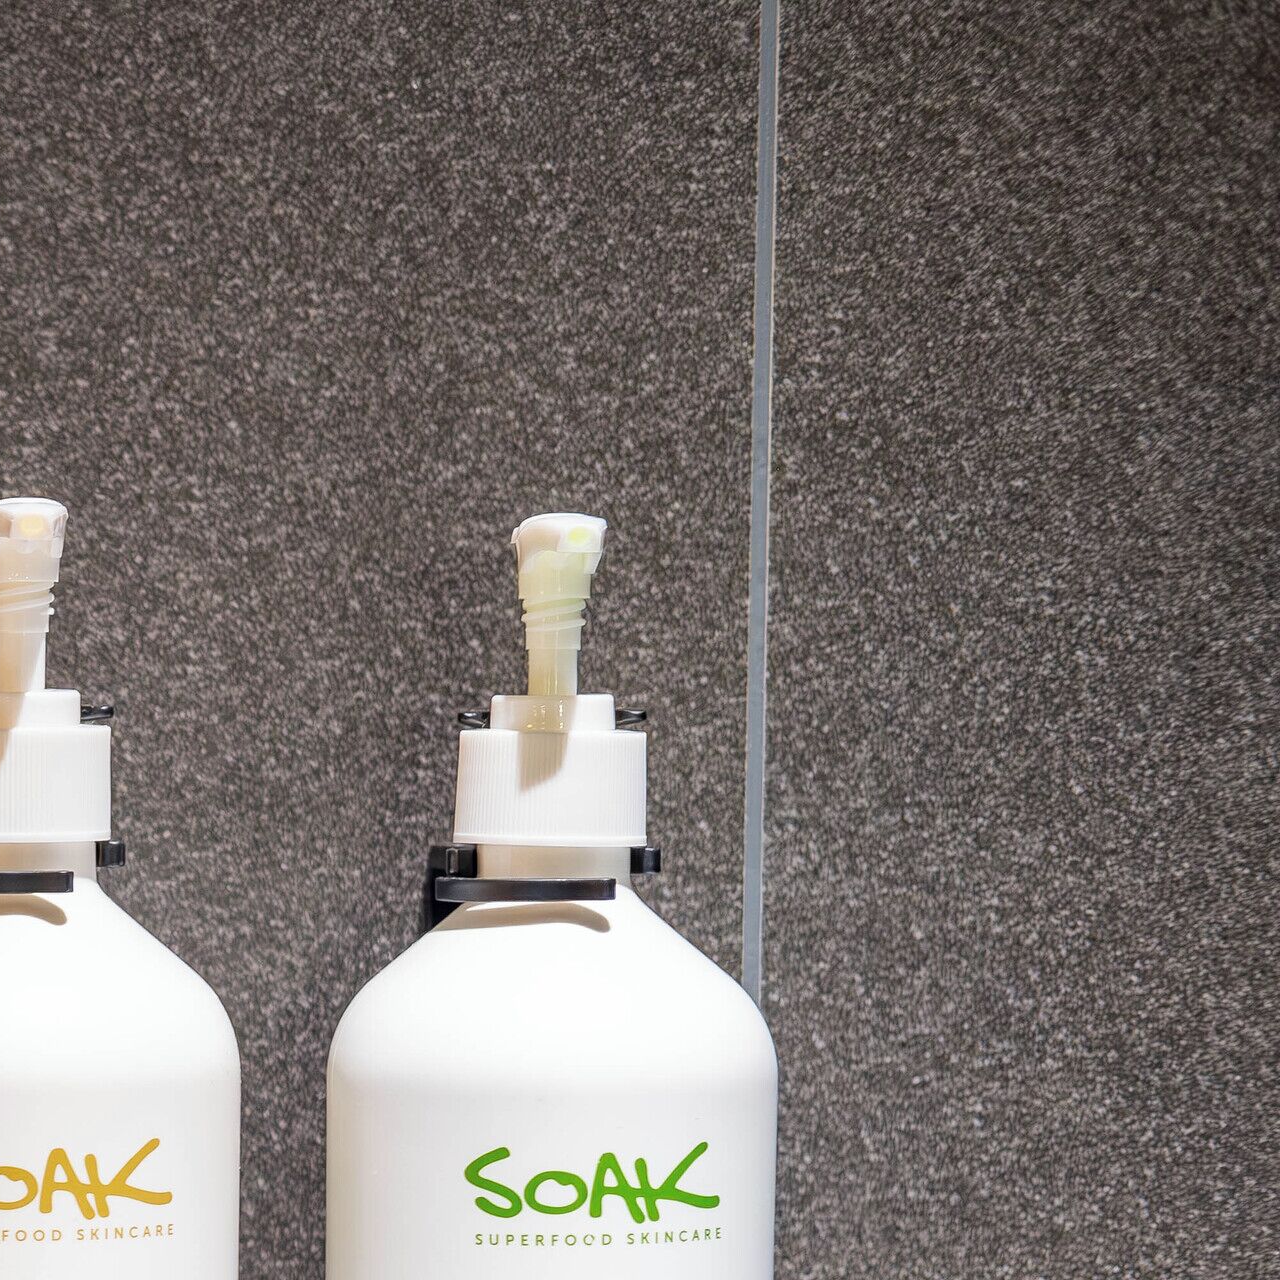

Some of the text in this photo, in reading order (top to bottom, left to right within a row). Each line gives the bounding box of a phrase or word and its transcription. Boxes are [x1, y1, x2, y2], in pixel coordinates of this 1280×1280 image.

[464, 1142, 720, 1224] SOAK
[76, 1224, 174, 1241] SKINCARE
[474, 1227, 722, 1246] SUPERFOOD SKINCARE
